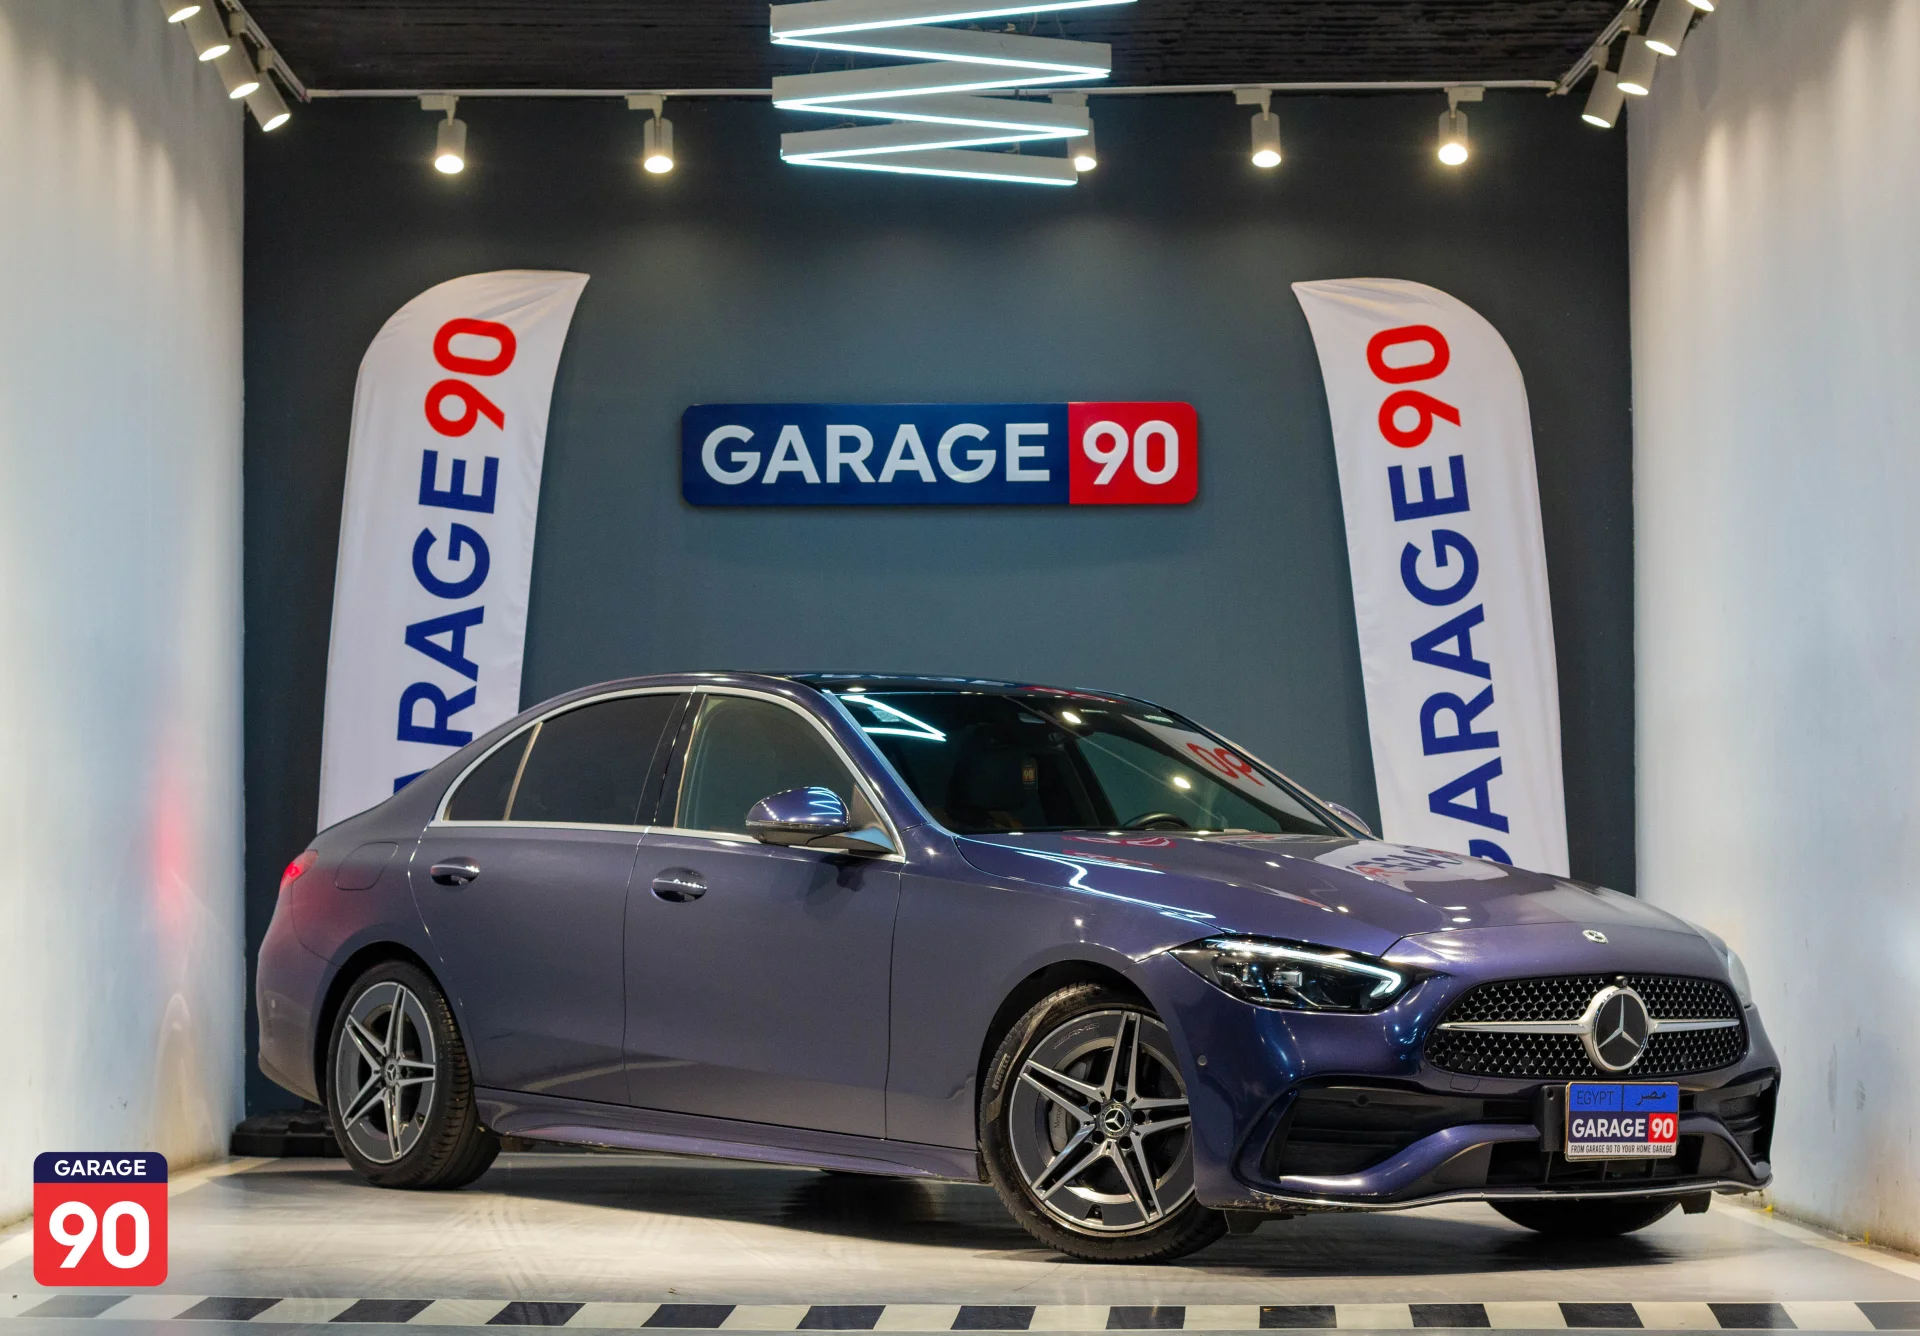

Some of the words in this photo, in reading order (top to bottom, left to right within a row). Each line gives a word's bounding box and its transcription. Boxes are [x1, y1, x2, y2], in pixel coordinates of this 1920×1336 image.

[701, 423, 1050, 485] GARAGE
[1082, 420, 1180, 485] 90
[395, 450, 499, 795] RAGE
[1577, 1090, 1614, 1105] EGYPT
[1635, 1090, 1667, 1106] مصر
[1572, 1118, 1646, 1138] GARAGE
[1651, 1118, 1674, 1139] 90
[1571, 1145, 1584, 1153] FROM
[1586, 1145, 1604, 1153] GARAGE
[1606, 1145, 1613, 1153] 90
[1614, 1145, 1620, 1153] TO
[1622, 1145, 1635, 1153] YOUR
[1636, 1145, 1651, 1153] HOME
[1653, 1145, 1672, 1153] GARAGE
